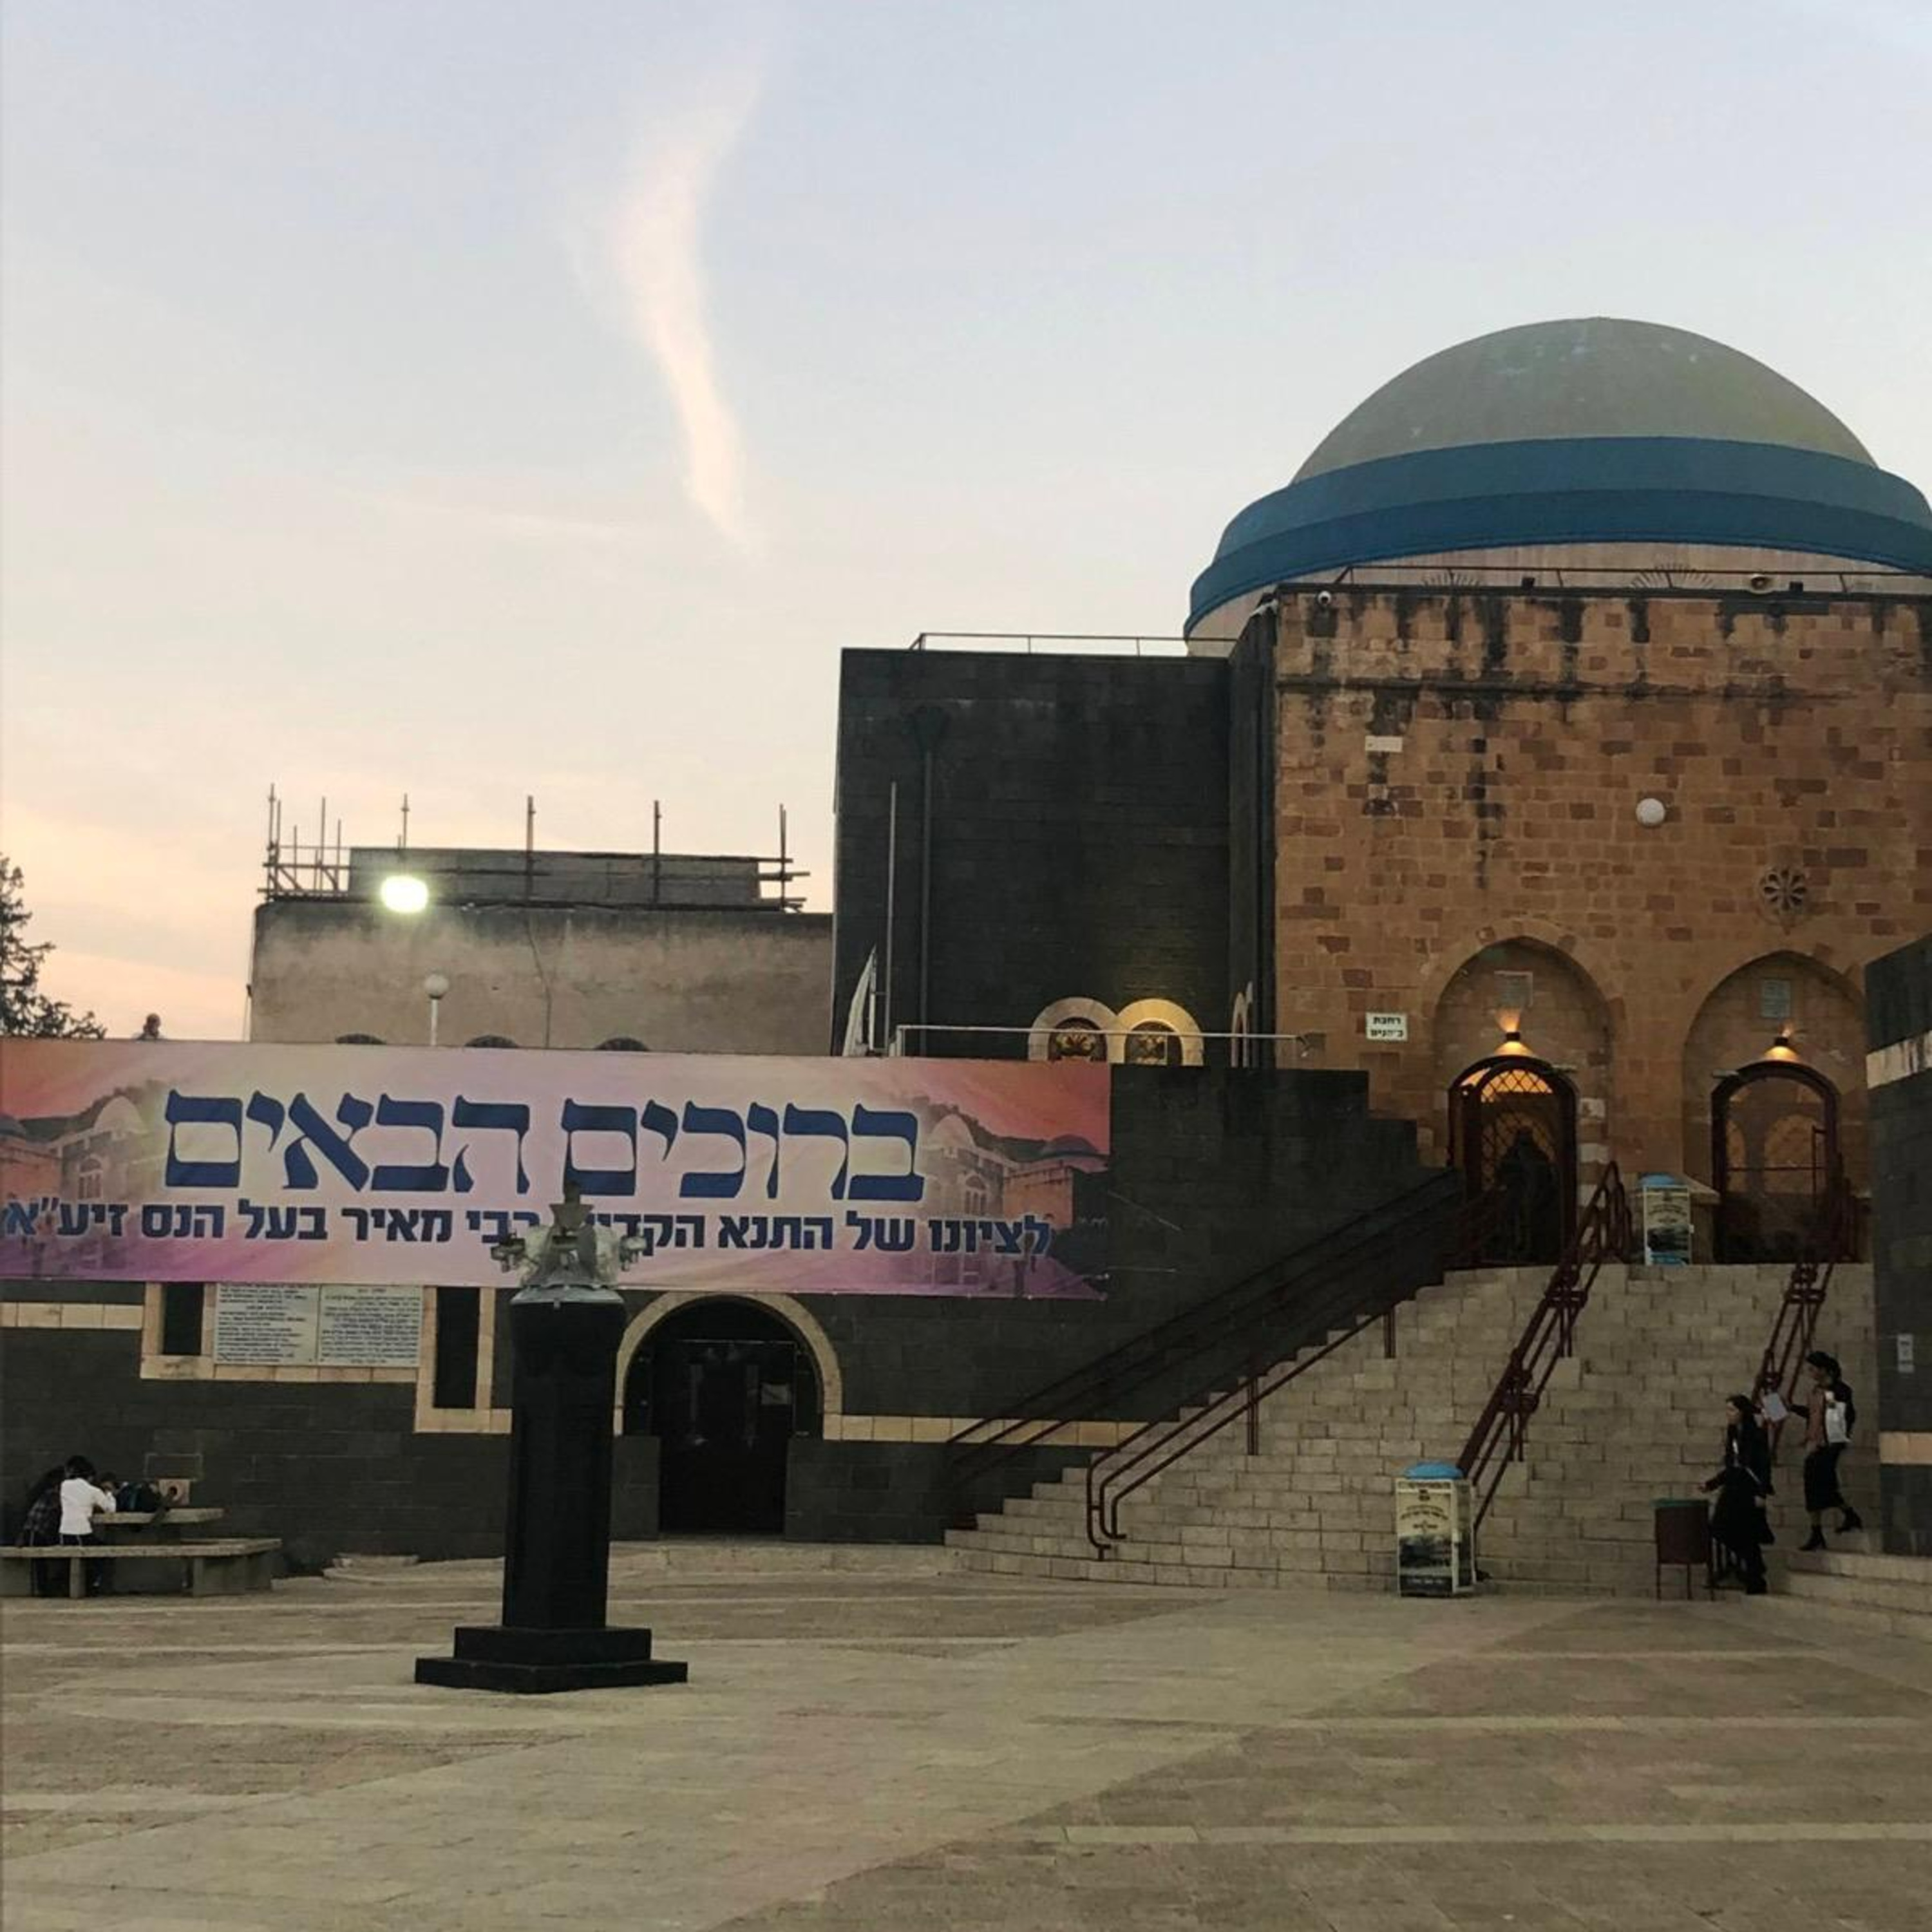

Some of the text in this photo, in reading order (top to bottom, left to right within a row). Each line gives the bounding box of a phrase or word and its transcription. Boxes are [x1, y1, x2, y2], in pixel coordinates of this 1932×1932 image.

[165, 1090, 924, 1202] ברוכים הבאים
[141, 1205, 224, 1238] הנס
[238, 1199, 327, 1240] בעל
[341, 1208, 453, 1242] מאיר
[583, 1213, 705, 1256] הקד
[718, 1215, 833, 1250] התנא
[846, 1211, 914, 1252] של
[928, 1215, 1050, 1255] לציונו
